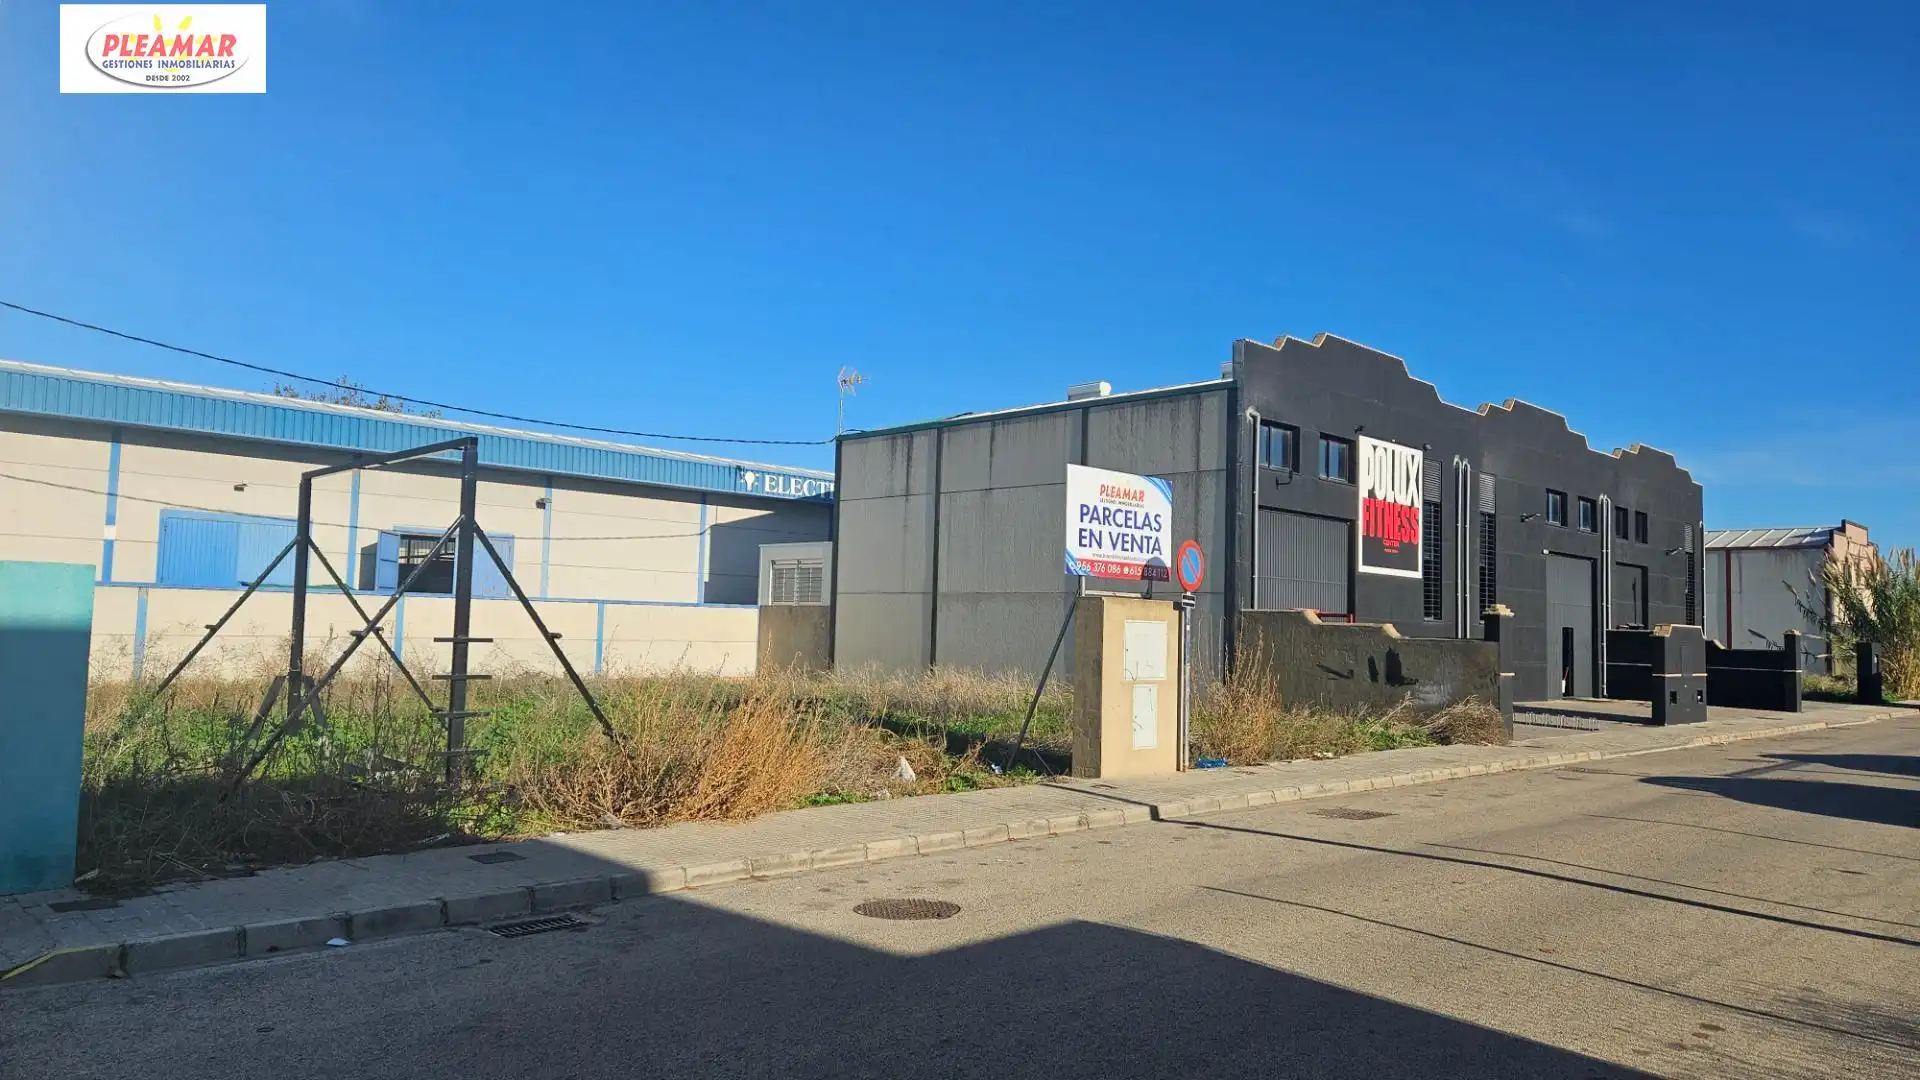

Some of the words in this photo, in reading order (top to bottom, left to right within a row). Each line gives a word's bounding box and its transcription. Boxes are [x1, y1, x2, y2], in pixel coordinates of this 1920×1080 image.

[1361, 442, 1420, 507] POLUX
[1100, 484, 1145, 502] PLEAMAR
[1080, 503, 1162, 532] PARCELAS
[1362, 497, 1420, 545] FITNESS
[1078, 527, 1103, 550] EN
[1108, 531, 1163, 555] VENTA
[1094, 562, 1106, 573] 376
[1107, 563, 1121, 574] 086
